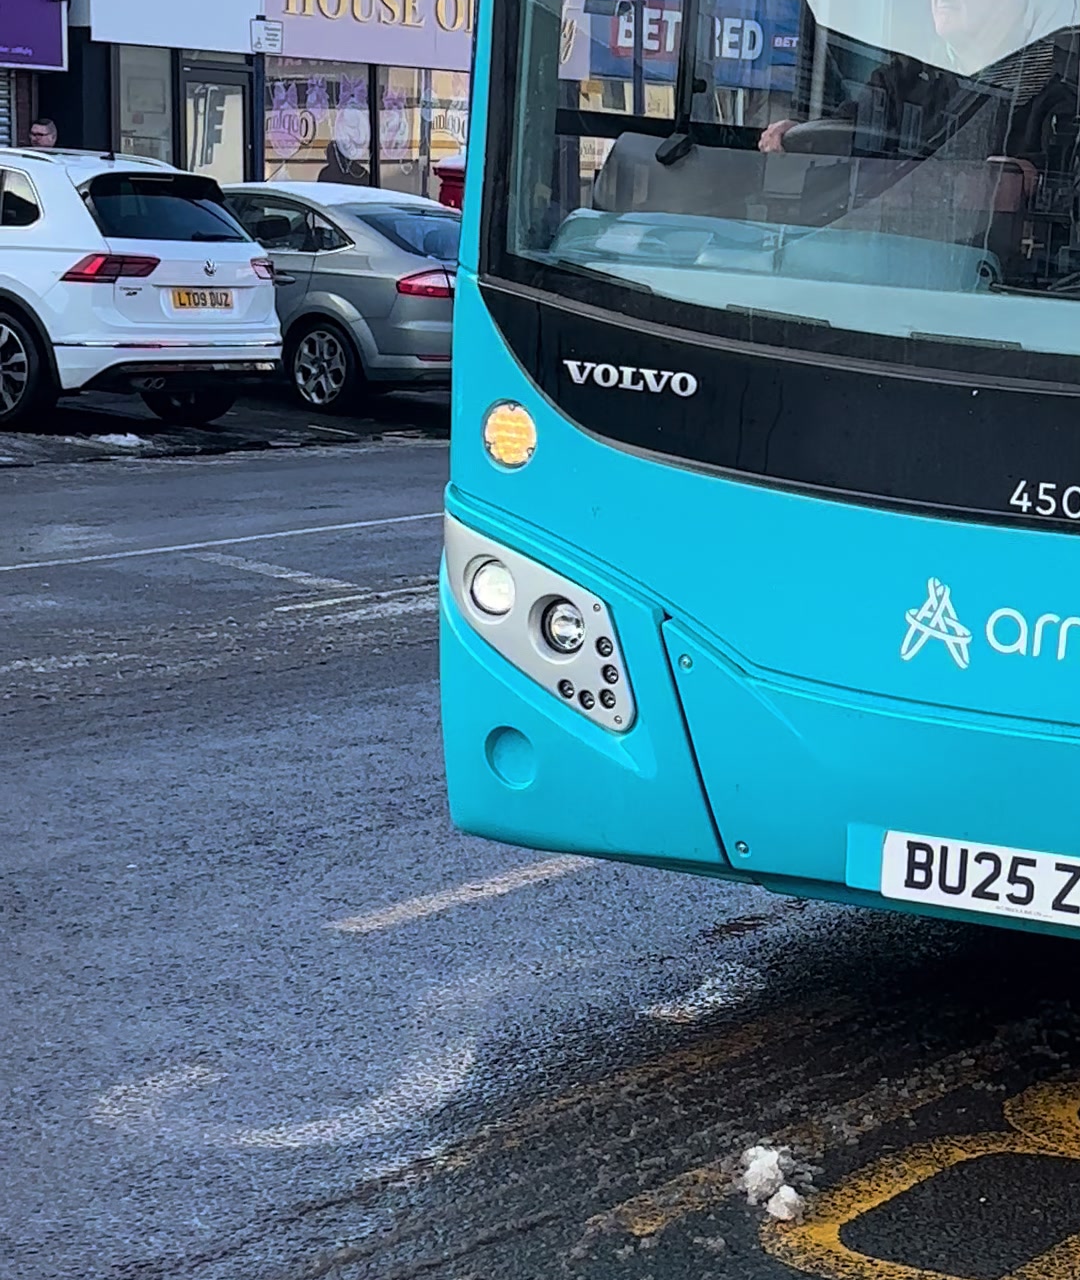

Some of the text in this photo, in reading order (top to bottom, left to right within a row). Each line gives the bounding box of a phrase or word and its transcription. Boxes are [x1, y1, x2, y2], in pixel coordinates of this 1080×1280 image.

[617, 6, 764, 60] BETED
[562, 359, 698, 397] VOLVO
[904, 840, 1037, 906] BU25
